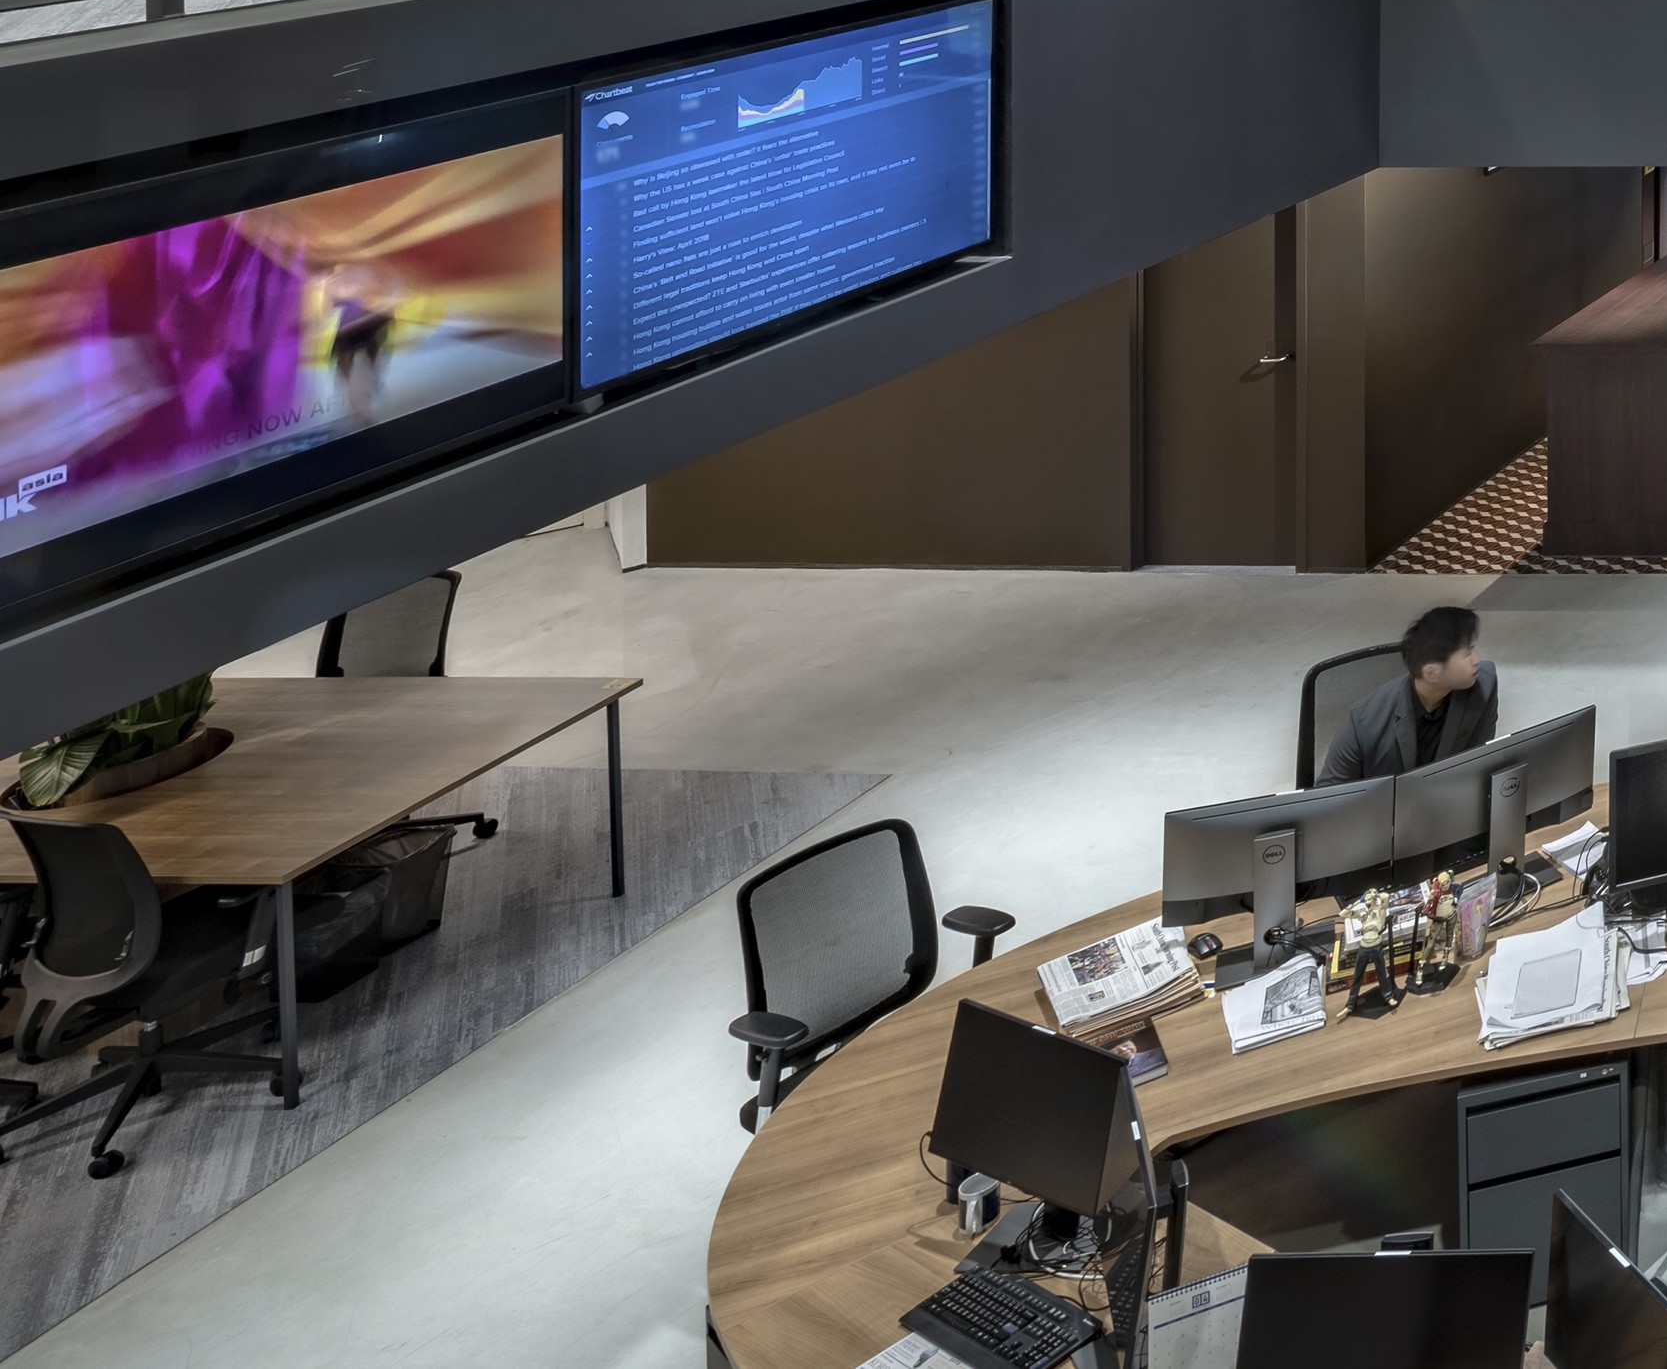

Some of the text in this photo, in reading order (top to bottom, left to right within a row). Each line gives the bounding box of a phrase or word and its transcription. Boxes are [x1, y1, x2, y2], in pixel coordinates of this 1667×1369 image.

[595, 85, 633, 100] Chartbeat
[21, 468, 65, 491] asia
[1265, 851, 1283, 859] DELL
